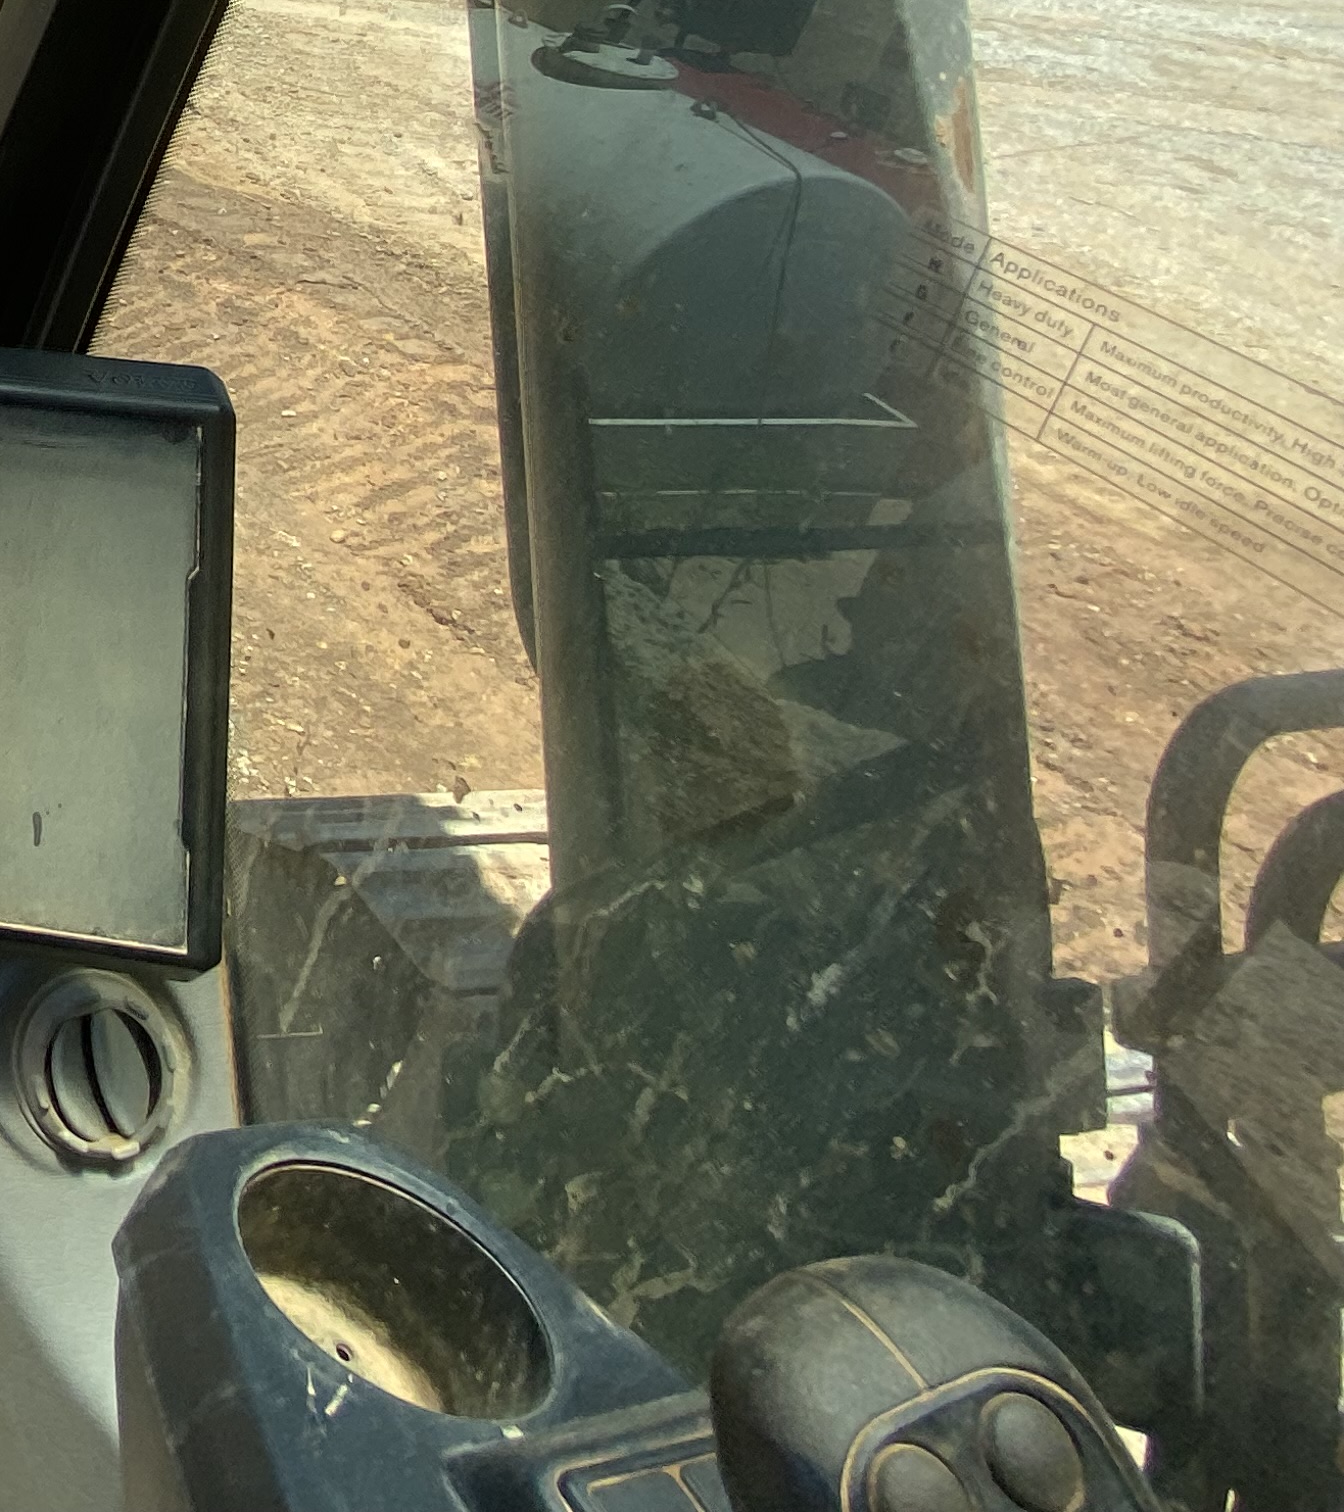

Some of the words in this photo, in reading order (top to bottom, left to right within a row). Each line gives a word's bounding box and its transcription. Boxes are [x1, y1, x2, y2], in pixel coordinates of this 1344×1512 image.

[978, 278, 1032, 317] Heavy
[1034, 310, 1074, 338] duty
[990, 251, 1121, 323] Applications
[964, 309, 1036, 355] General
[991, 360, 1054, 400] control
[1084, 371, 1127, 400] Most
[1127, 396, 1195, 436] general
[1100, 341, 1178, 389] Maximum
[1292, 438, 1337, 470] High
[1070, 399, 1147, 449] Maximum
[1148, 442, 1197, 480] lifting
[1210, 517, 1265, 554] speed
